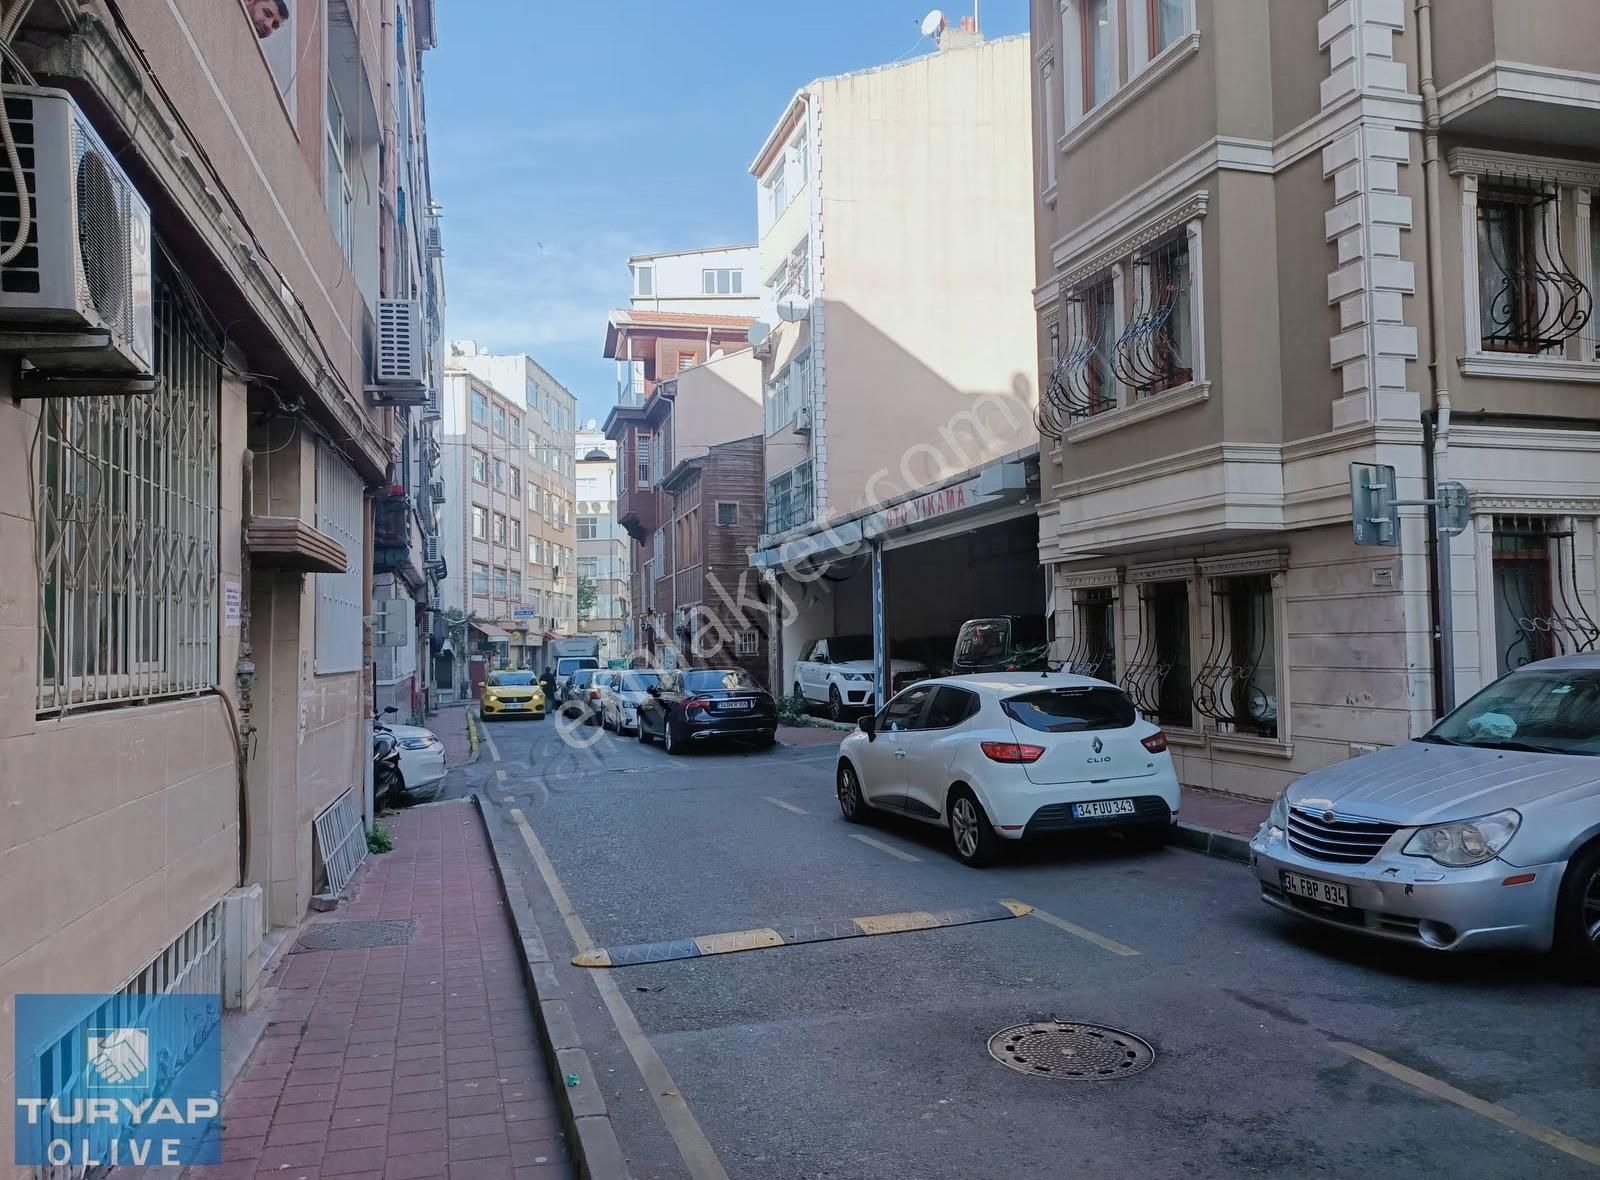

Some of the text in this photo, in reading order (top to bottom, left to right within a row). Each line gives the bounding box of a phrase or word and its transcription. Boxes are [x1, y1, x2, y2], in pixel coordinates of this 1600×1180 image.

[886, 486, 967, 528] OTO YIKAMA
[1086, 756, 1111, 764] CLIO
[1078, 800, 1133, 816] 34 FUU 343
[1286, 875, 1345, 904] 34 FBP 834
